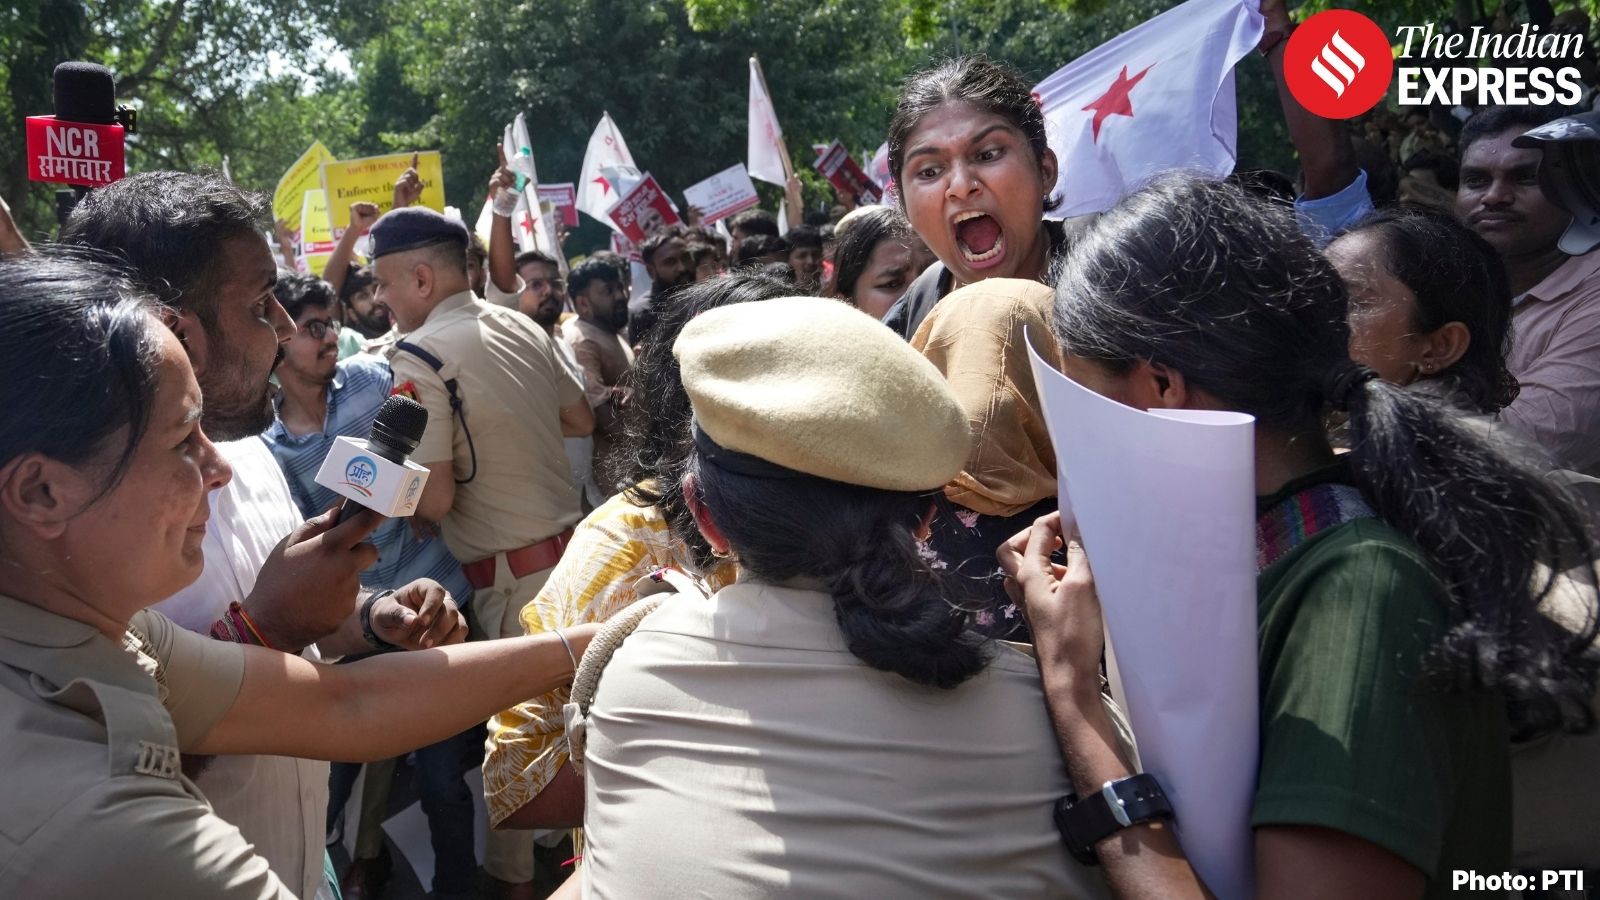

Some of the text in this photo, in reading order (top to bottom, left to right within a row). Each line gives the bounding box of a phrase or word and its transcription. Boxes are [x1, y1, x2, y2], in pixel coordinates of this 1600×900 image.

[46, 125, 99, 158] NCR
[37, 155, 112, 182] समाचार
[336, 185, 380, 199] Enforce
